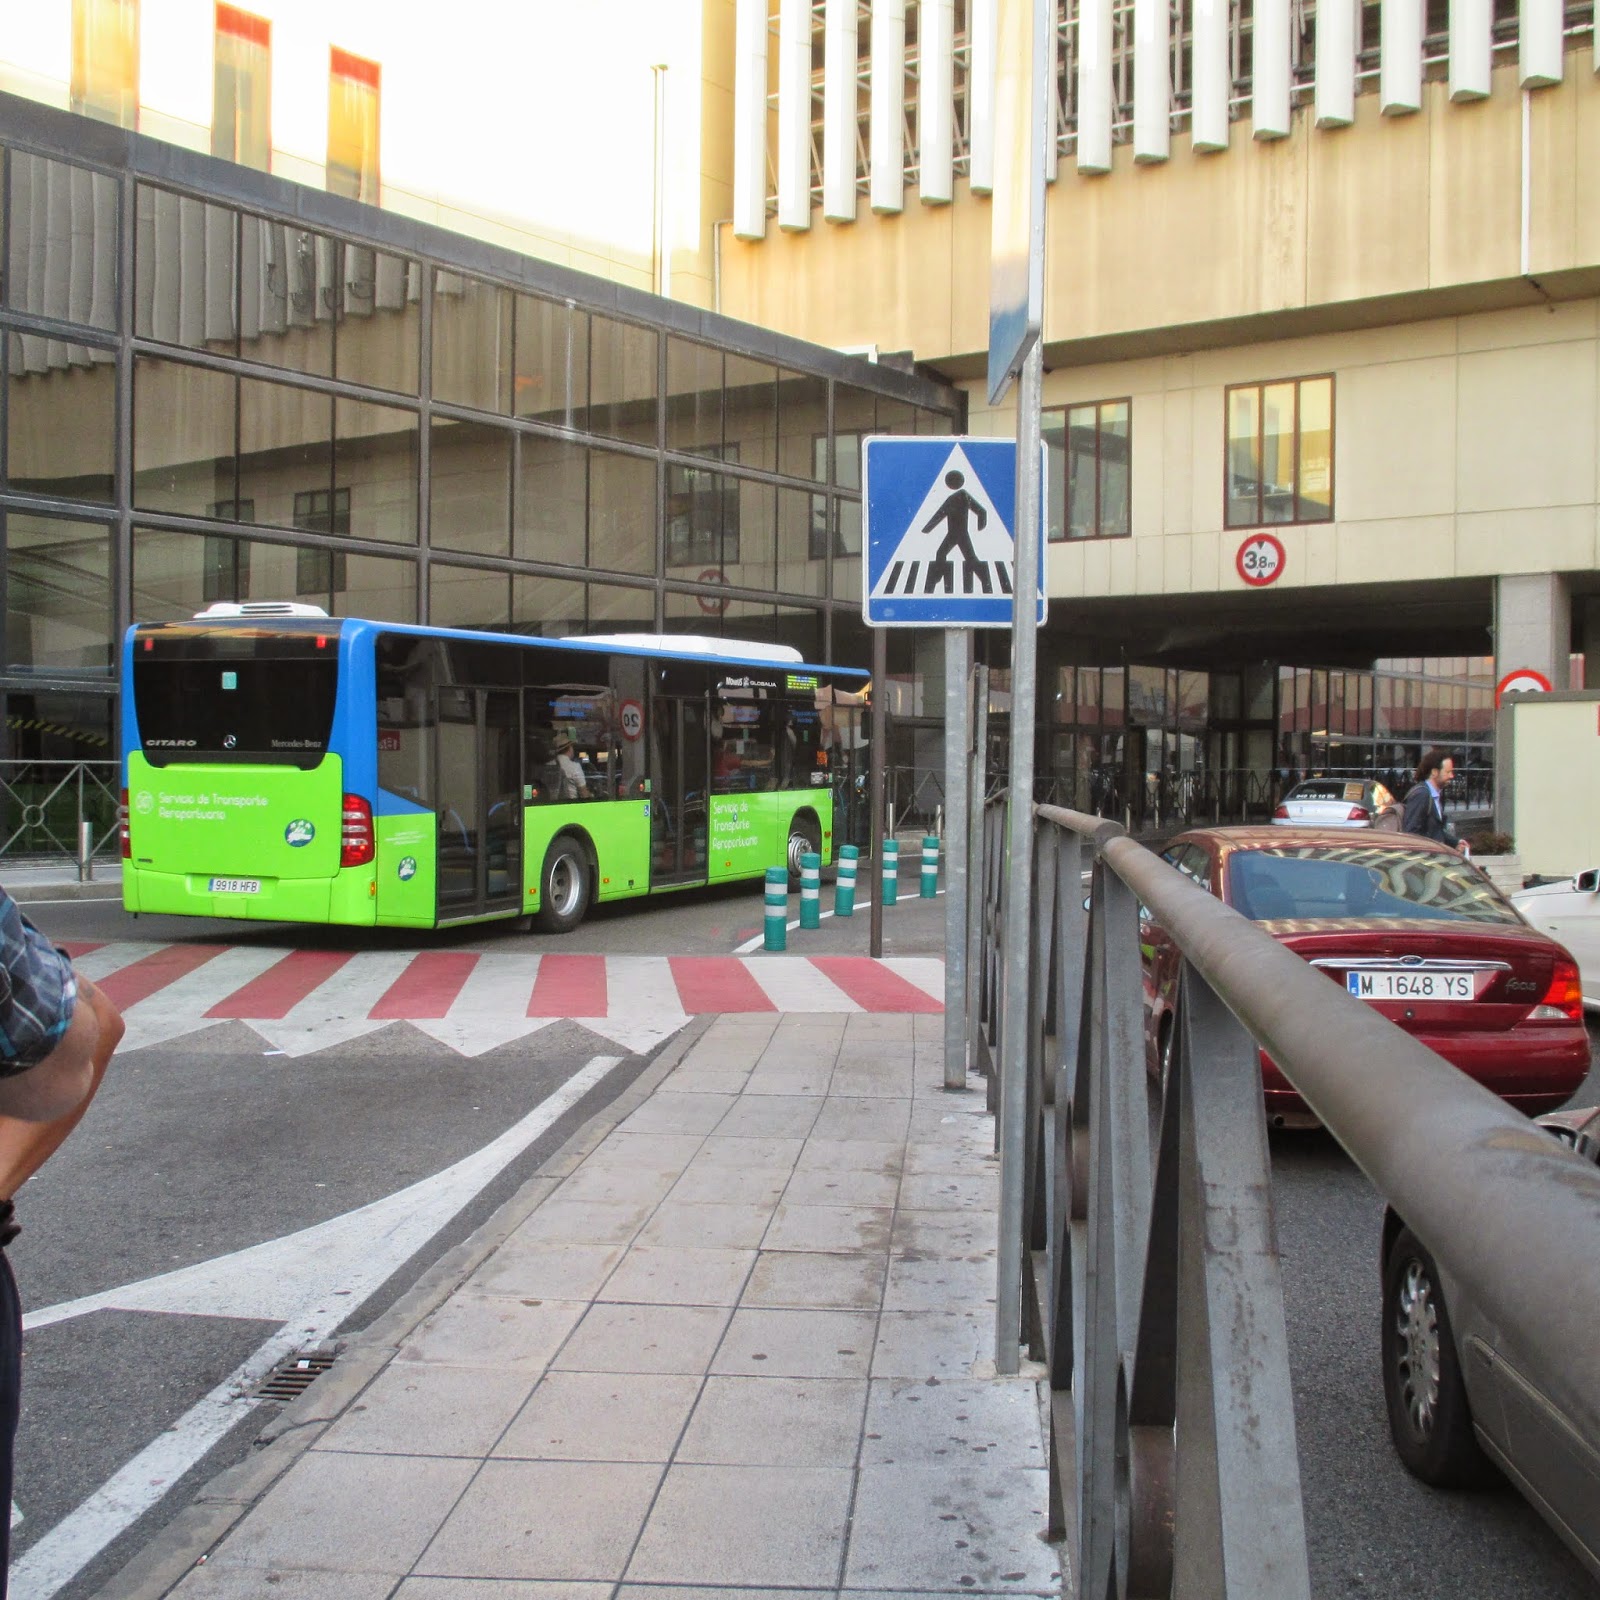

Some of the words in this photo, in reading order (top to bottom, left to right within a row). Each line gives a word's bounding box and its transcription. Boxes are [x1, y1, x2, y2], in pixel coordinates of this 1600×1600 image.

[749, 680, 777, 688] GLOBALIA
[146, 739, 197, 747] CITARO
[271, 739, 322, 748] Mercedes-Benz
[159, 792, 195, 804] Servicio
[197, 793, 210, 805] de
[212, 793, 269, 808] Transporte
[159, 807, 226, 821] Aeroportuario
[713, 801, 738, 815] Servicio
[740, 800, 749, 812] de
[713, 819, 750, 833] Transporte
[713, 836, 758, 851] Aeroportuario
[215, 880, 237, 891] 9918
[240, 881, 258, 892] HFB
[1361, 975, 1373, 995] M
[1386, 975, 1434, 995] 1648
[1444, 976, 1469, 996] YS
